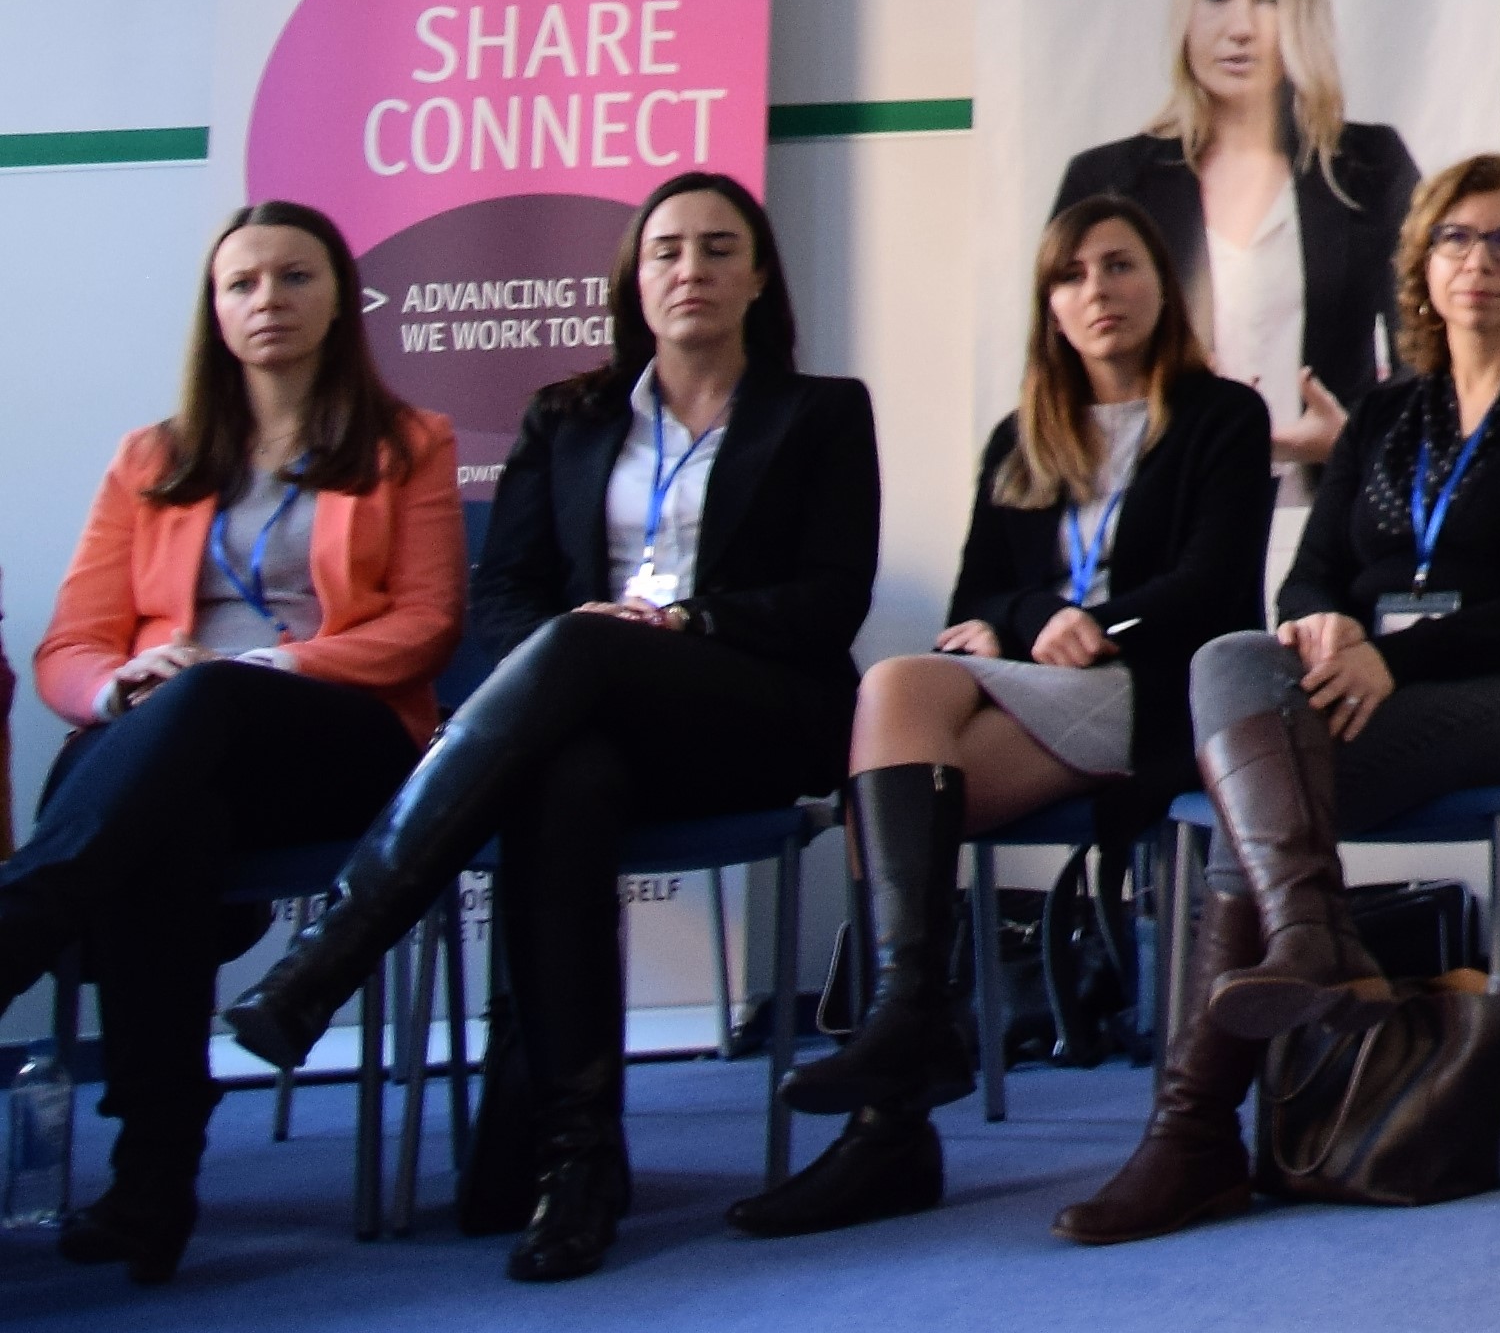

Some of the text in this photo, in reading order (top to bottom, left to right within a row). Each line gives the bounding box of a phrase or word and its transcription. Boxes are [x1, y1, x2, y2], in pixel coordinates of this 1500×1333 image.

[412, 0, 682, 84] SHARE
[363, 89, 726, 176] CONNECT
[401, 278, 576, 314] ADVANCING
[400, 322, 447, 354] WE
[452, 318, 541, 351] WORK
